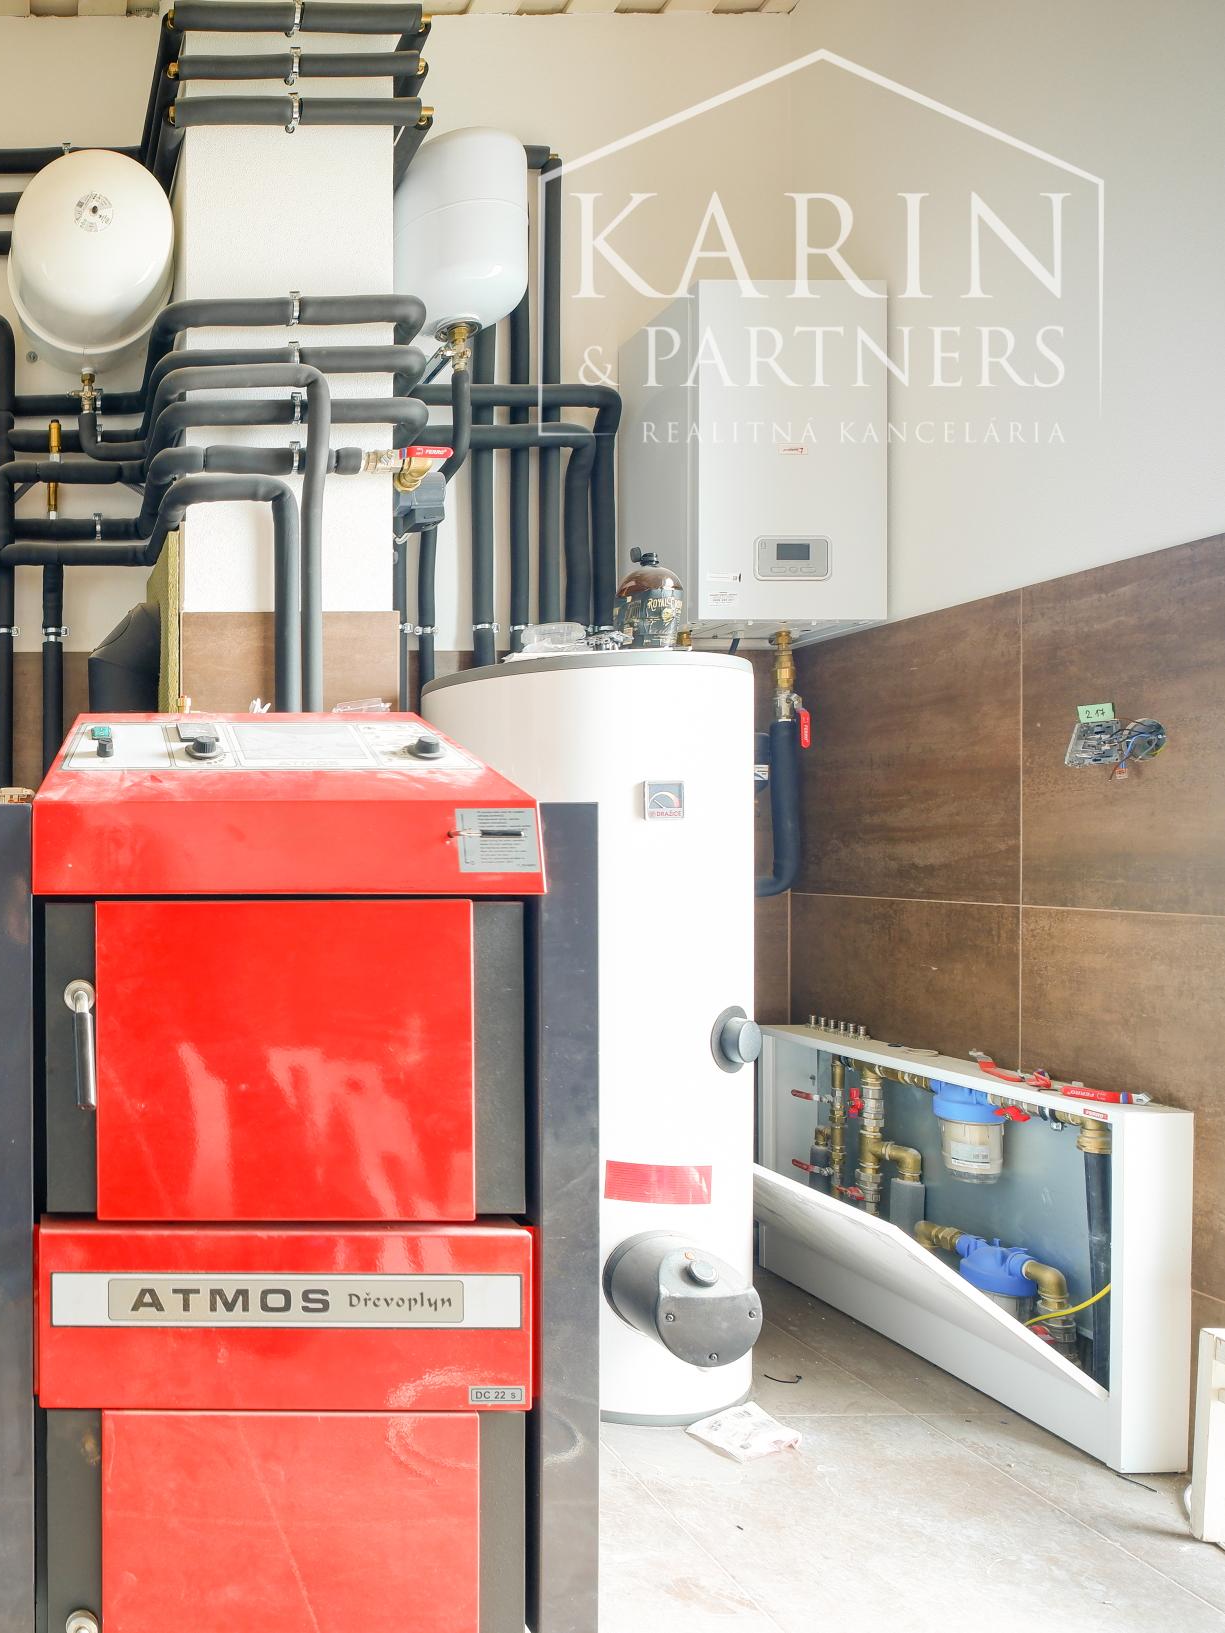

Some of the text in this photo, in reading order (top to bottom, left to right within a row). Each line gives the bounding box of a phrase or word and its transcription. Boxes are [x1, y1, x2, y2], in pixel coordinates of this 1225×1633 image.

[130, 1288, 453, 1313] ATMOS Dřevoplyn
[475, 1390, 491, 1400] DC
[494, 1390, 506, 1400] 22
